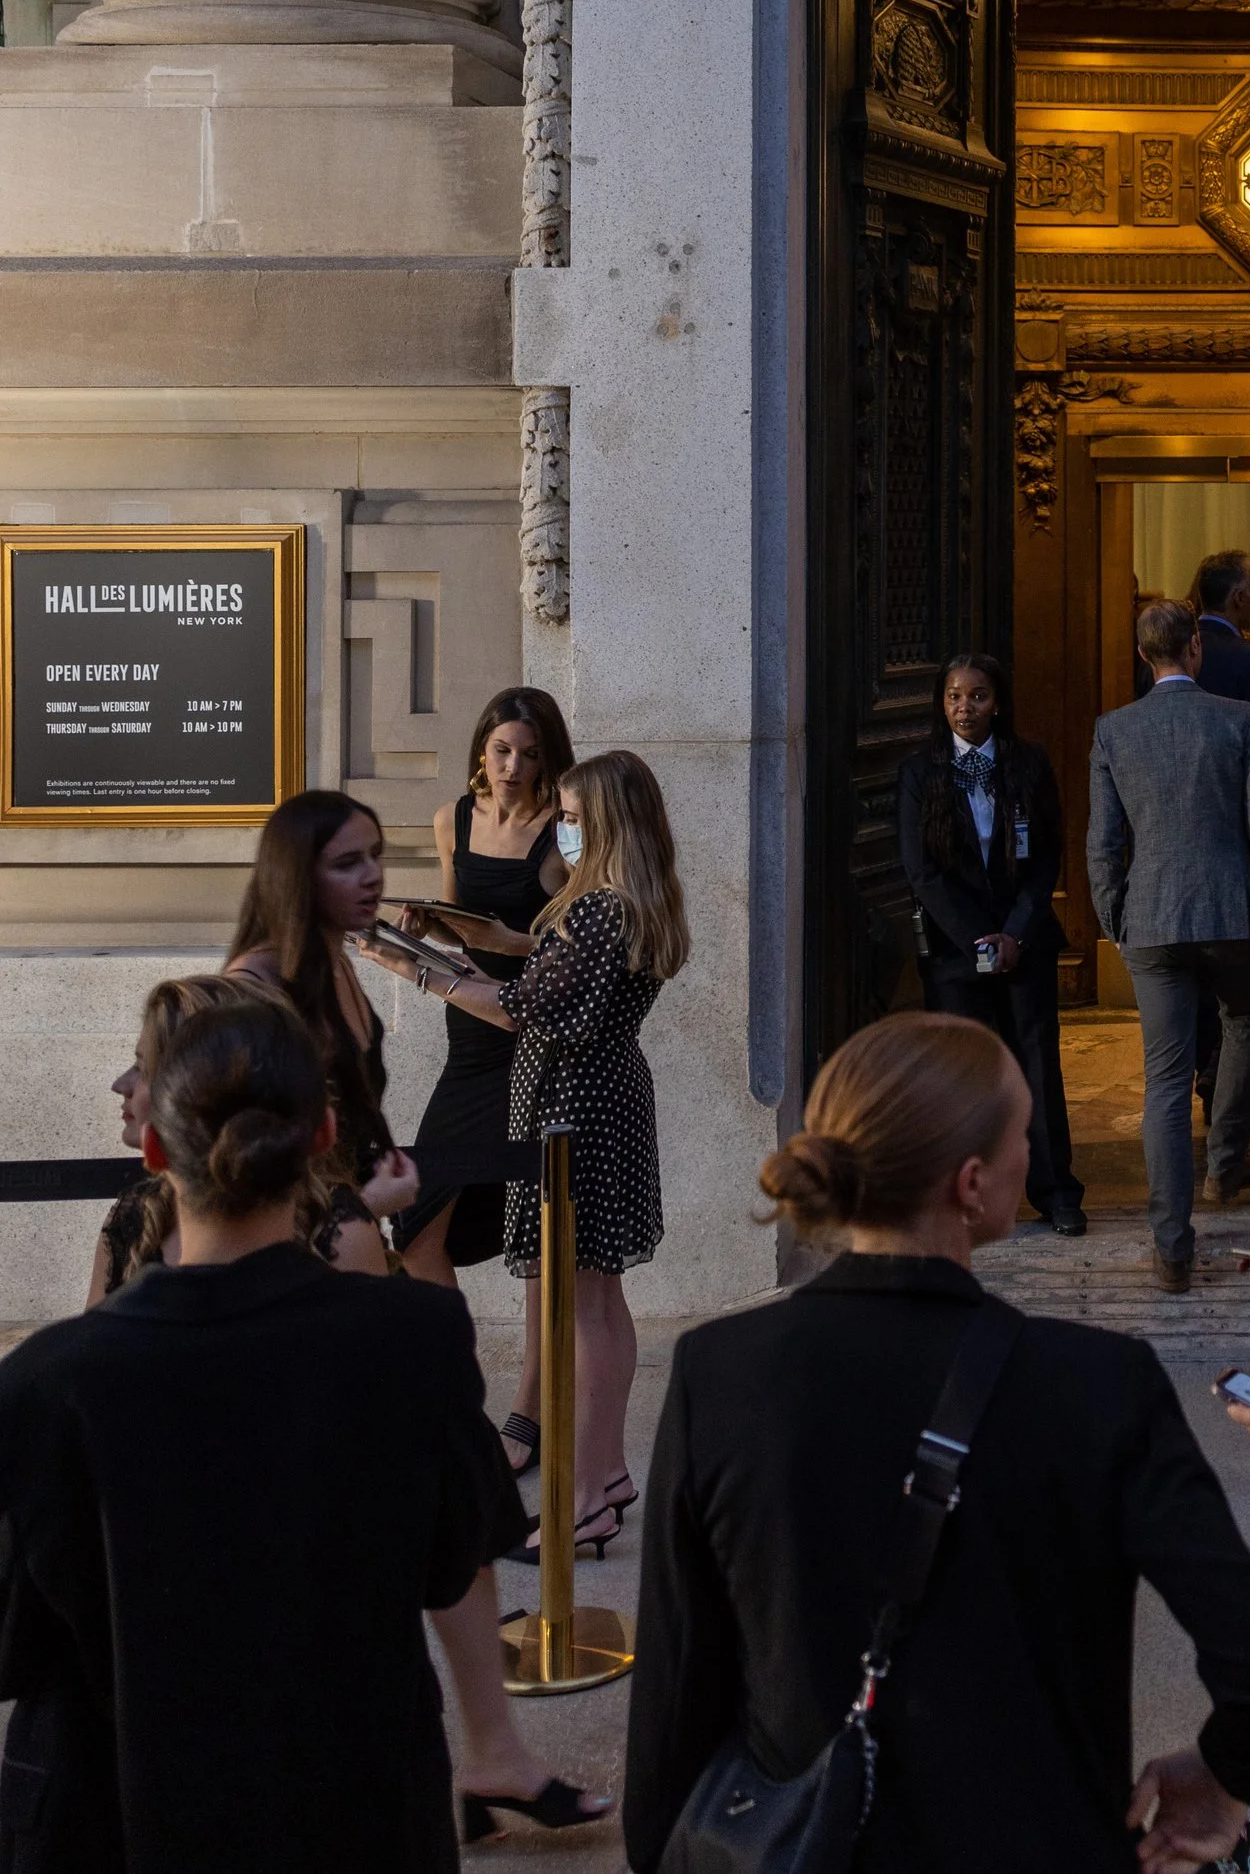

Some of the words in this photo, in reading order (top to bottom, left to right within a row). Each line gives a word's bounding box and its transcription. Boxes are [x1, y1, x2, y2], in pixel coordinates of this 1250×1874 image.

[45, 585, 125, 613] HALL
[101, 584, 125, 601] DES
[129, 579, 243, 613] LUMIÈRES
[177, 617, 205, 625] NEW
[210, 616, 243, 625] YORK
[46, 664, 81, 682] OPEN
[86, 664, 129, 681] EVERY
[133, 663, 160, 681] DAY
[46, 702, 77, 713] SUNDAY
[101, 701, 150, 712] WEDNESDAY
[187, 700, 198, 711] 10
[200, 700, 213, 711] AM
[222, 700, 228, 711] 7
[230, 700, 243, 711] PM
[46, 723, 87, 734] THURSDAY
[111, 722, 152, 733] SATURDAY
[182, 721, 193, 732] 10
[194, 721, 208, 732] AM
[217, 721, 228, 732] 10
[230, 721, 243, 732] PM
[46, 779, 81, 787] Exhibitions
[94, 779, 136, 788] continuously
[186, 787, 212, 796] closing.
